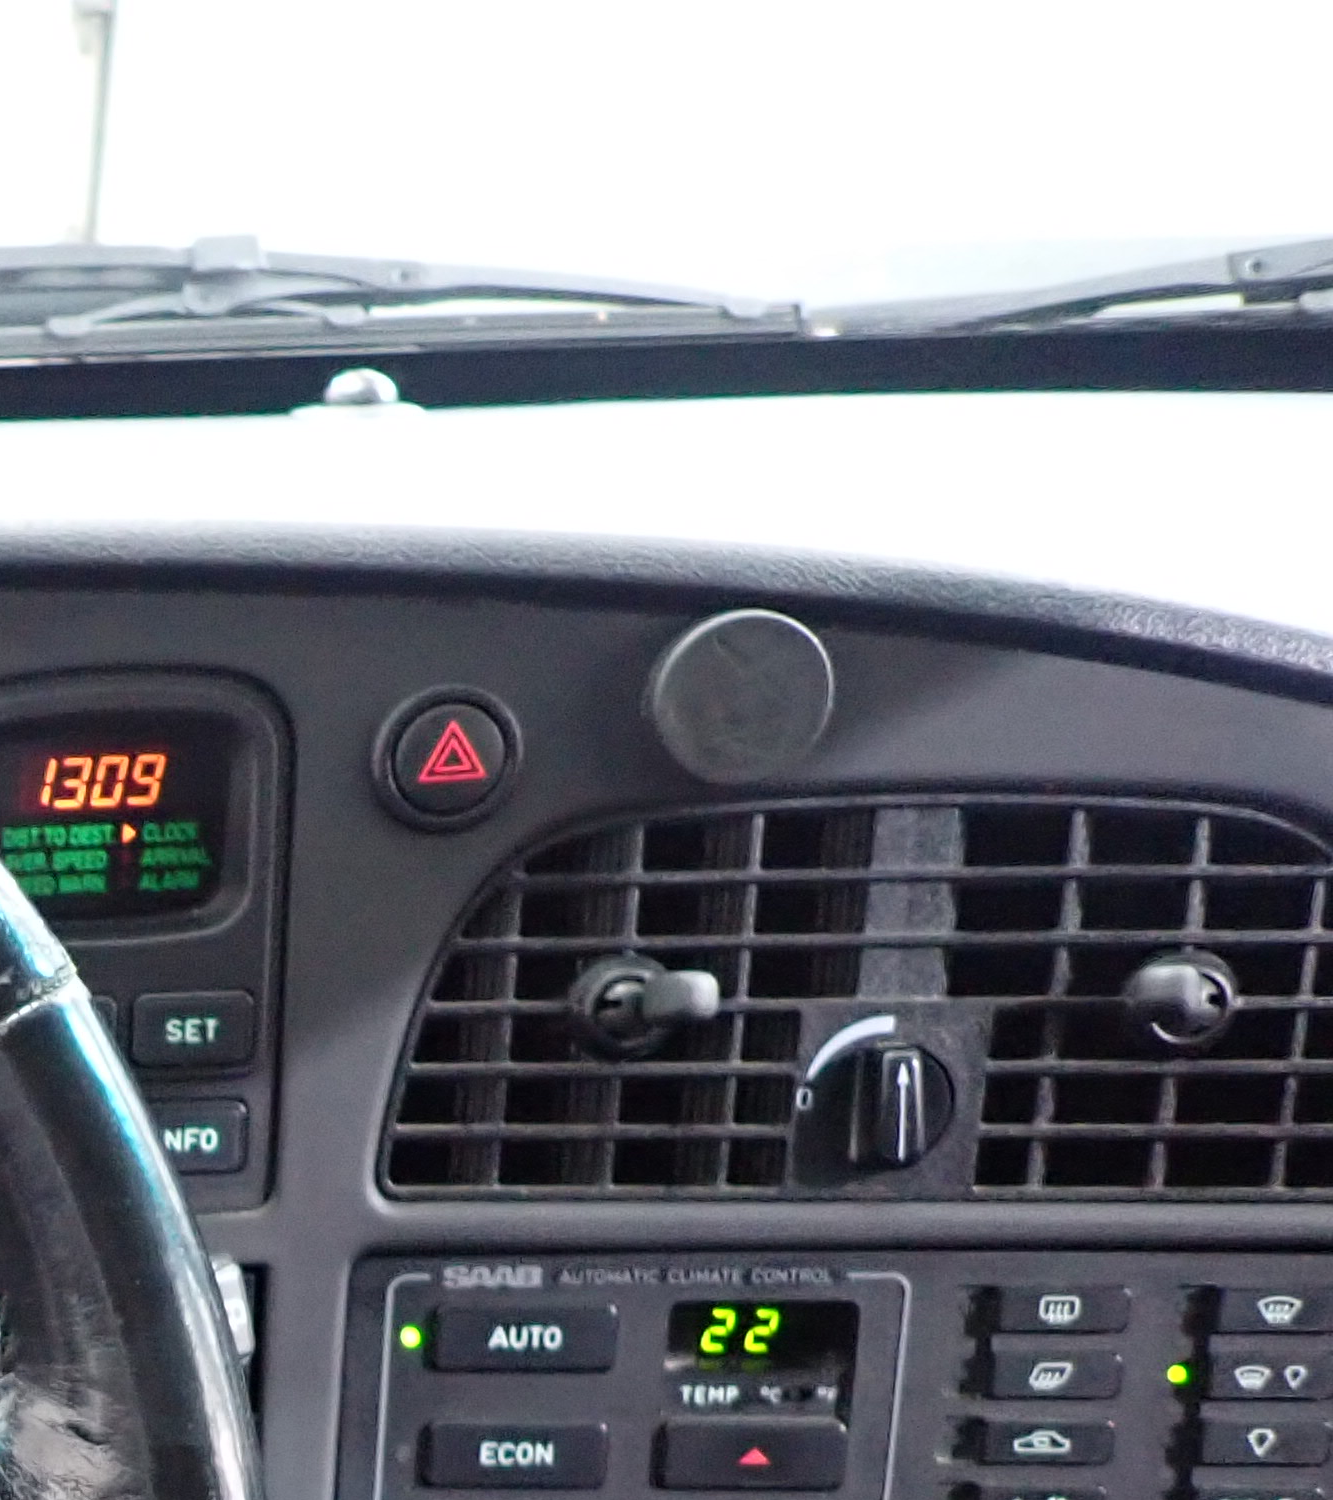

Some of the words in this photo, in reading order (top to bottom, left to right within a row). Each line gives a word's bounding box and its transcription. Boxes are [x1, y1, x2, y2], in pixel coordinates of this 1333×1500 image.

[40, 753, 166, 809] 1309
[165, 1017, 219, 1044] SET
[163, 1127, 219, 1154] NFO
[443, 1265, 543, 1289] SAAB
[487, 1324, 564, 1351] AUTO
[700, 1307, 780, 1353] 22
[680, 1384, 740, 1406] TEMP
[479, 1440, 555, 1467] ECON
